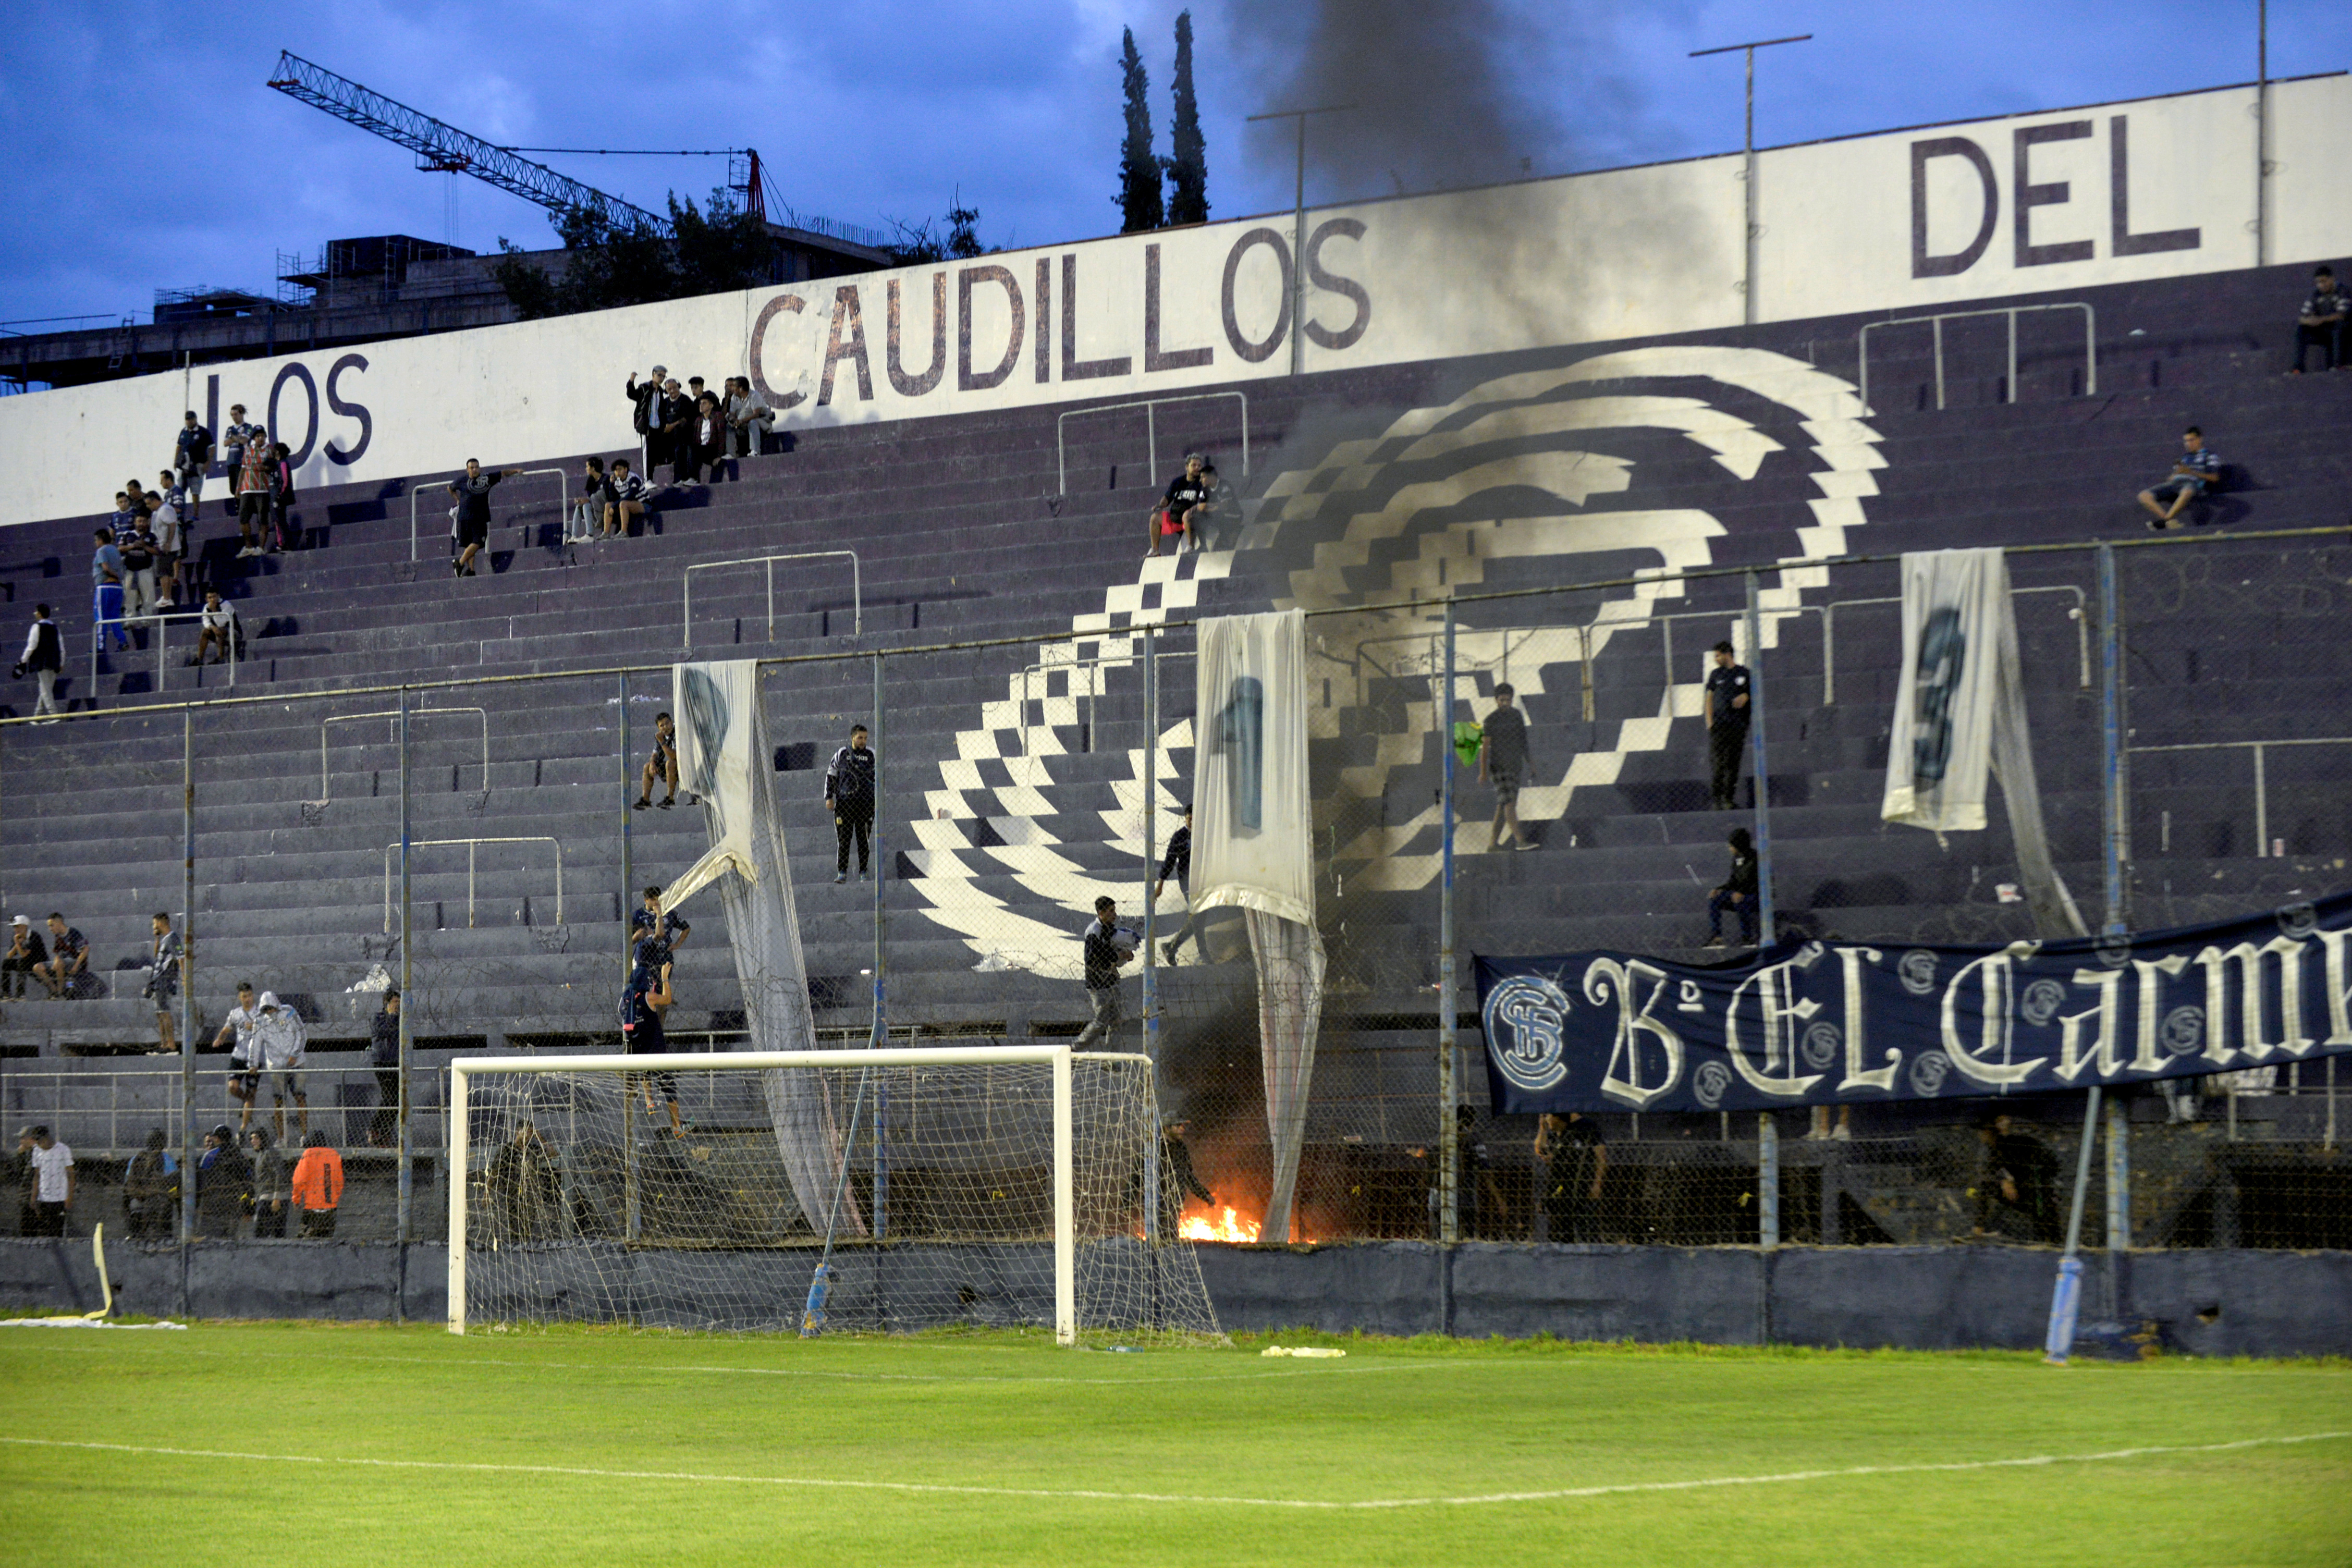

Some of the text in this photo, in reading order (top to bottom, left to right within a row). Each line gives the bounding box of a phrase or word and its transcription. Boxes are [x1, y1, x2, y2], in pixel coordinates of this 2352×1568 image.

[205, 114, 2201, 480] LOS CAUDILLOS DEL
